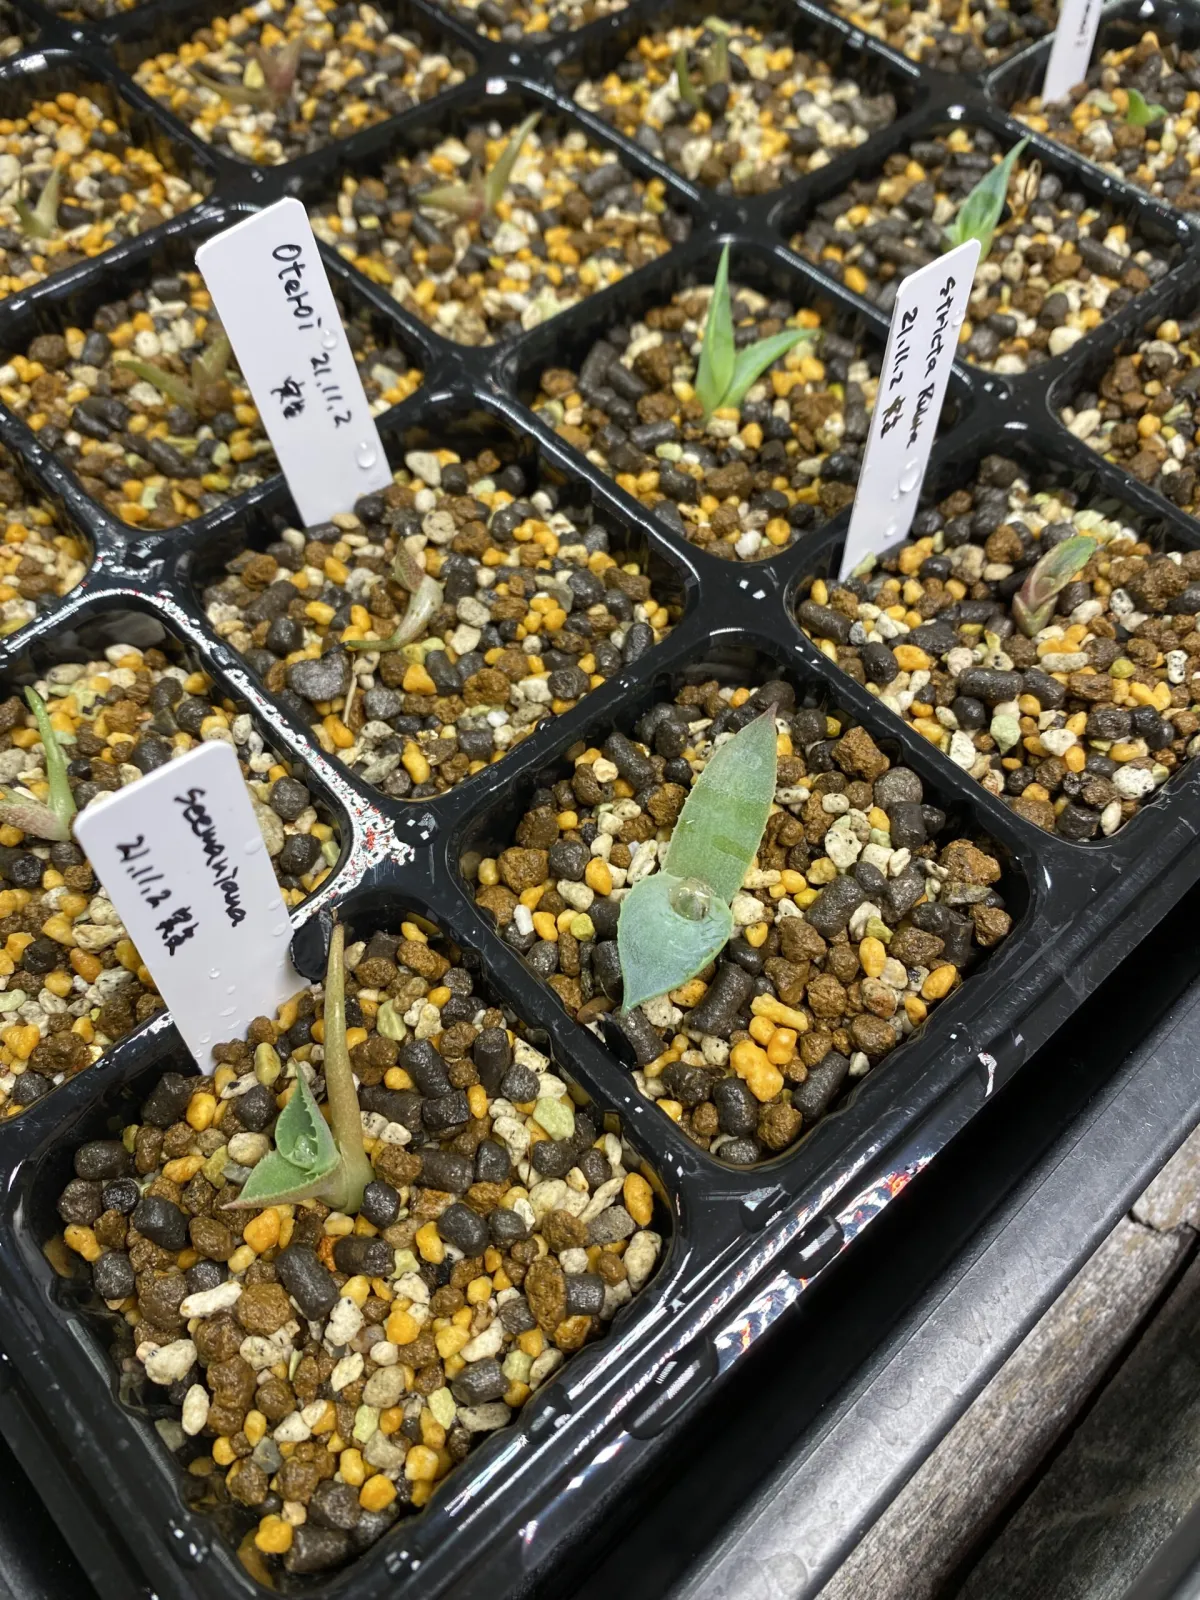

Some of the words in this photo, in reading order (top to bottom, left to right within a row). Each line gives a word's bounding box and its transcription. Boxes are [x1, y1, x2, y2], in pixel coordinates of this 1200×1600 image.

[888, 306, 919, 391] 21.11.2
[310, 352, 352, 428] 21.11.2
[115, 834, 172, 909] 21.11.2
